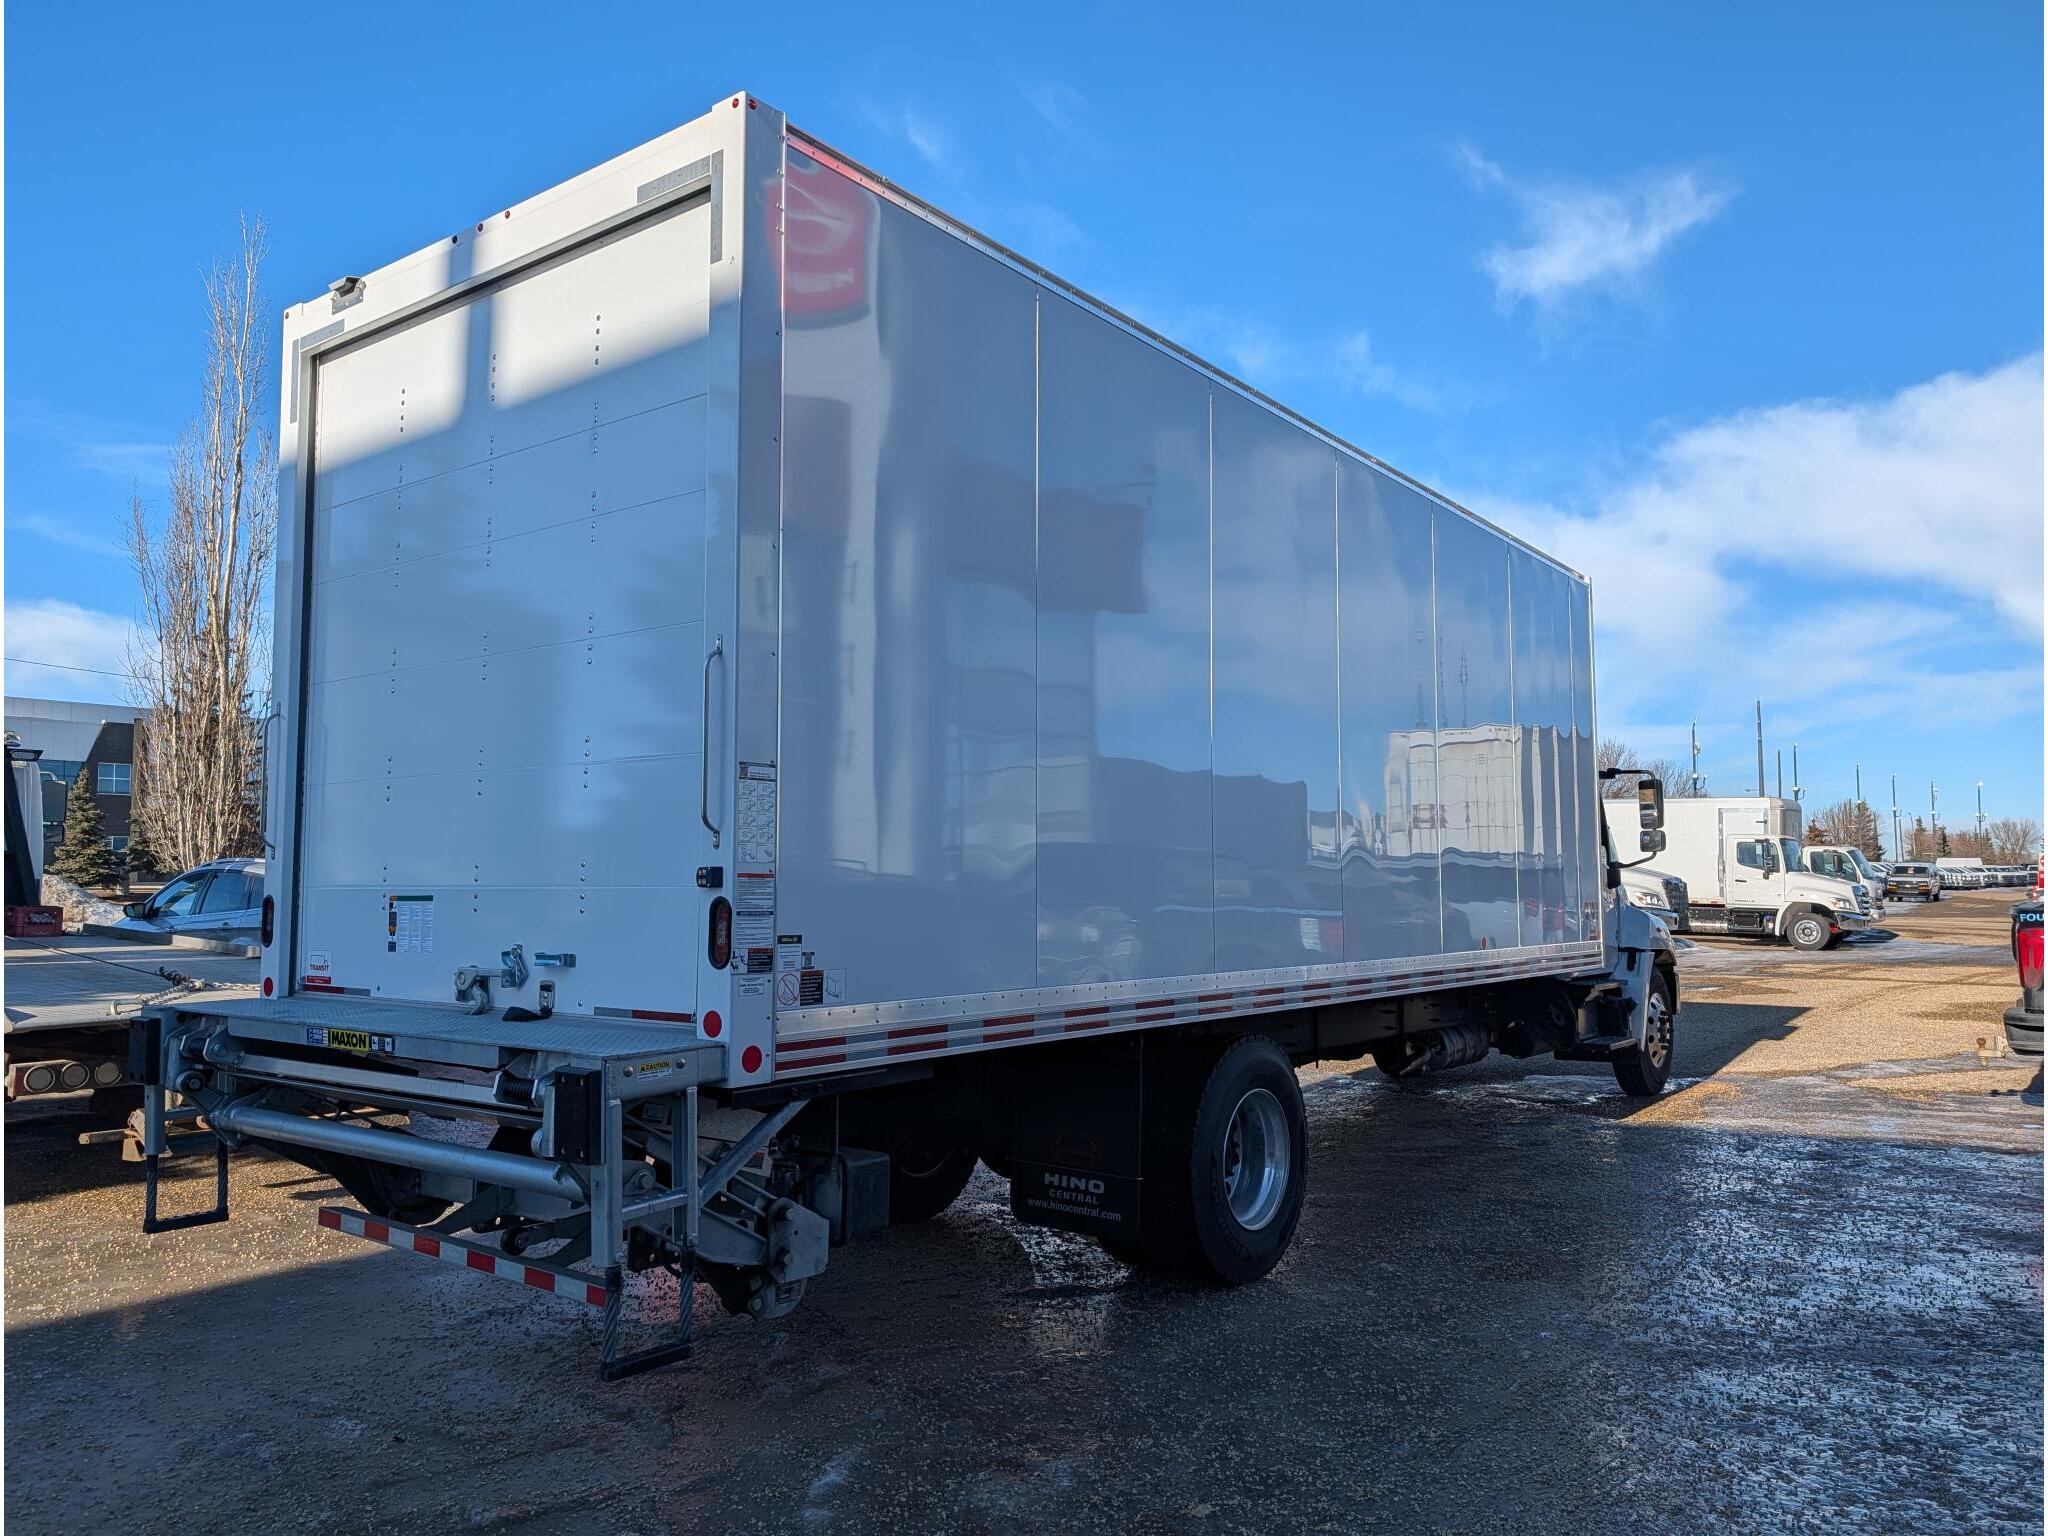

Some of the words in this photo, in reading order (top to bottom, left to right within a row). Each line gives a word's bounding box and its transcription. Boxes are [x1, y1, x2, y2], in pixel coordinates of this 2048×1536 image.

[331, 1030, 367, 1049] MAXON
[645, 1061, 670, 1071] CAUTION
[1044, 1172, 1105, 1194] HINO
[1049, 1188, 1100, 1205] CENTRAL
[1027, 1198, 1122, 1222] www.hinocentral.com
